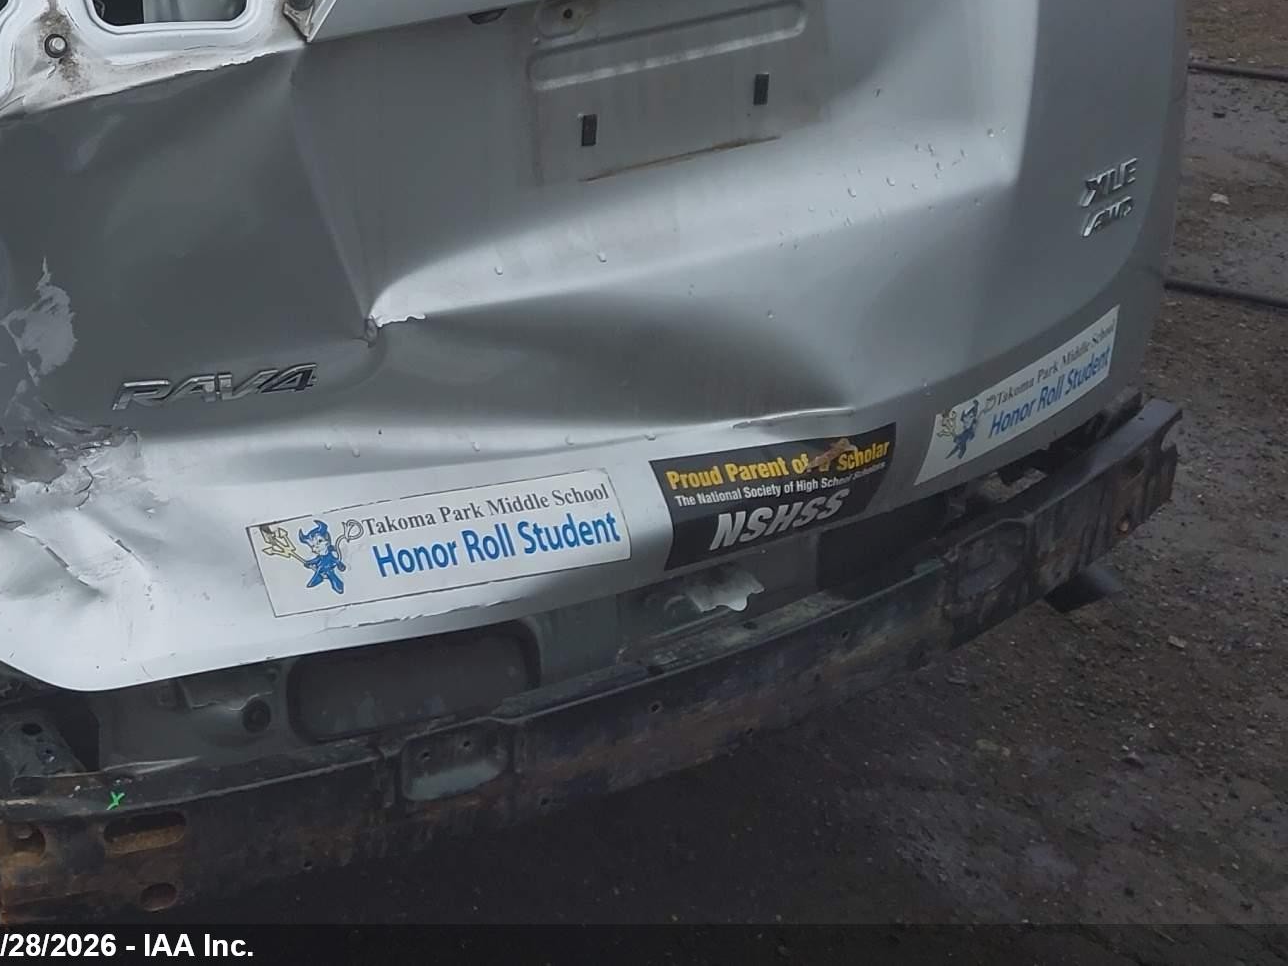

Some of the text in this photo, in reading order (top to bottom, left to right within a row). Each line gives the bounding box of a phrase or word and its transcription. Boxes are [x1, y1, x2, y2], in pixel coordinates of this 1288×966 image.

[1079, 157, 1138, 207] XLE
[112, 362, 317, 411] RAV4
[989, 346, 1110, 439] Honor Roll Student
[666, 466, 723, 490] Proud
[725, 457, 789, 482] Parent
[792, 454, 809, 474] of
[675, 495, 696, 507] The
[697, 488, 742, 505] National
[743, 483, 781, 499] Society
[784, 481, 794, 494] of
[796, 477, 819, 494] High
[362, 483, 610, 536] Takoma Park Middle School
[709, 488, 850, 551] NSHSS
[372, 512, 621, 578] Honor Roll Student
